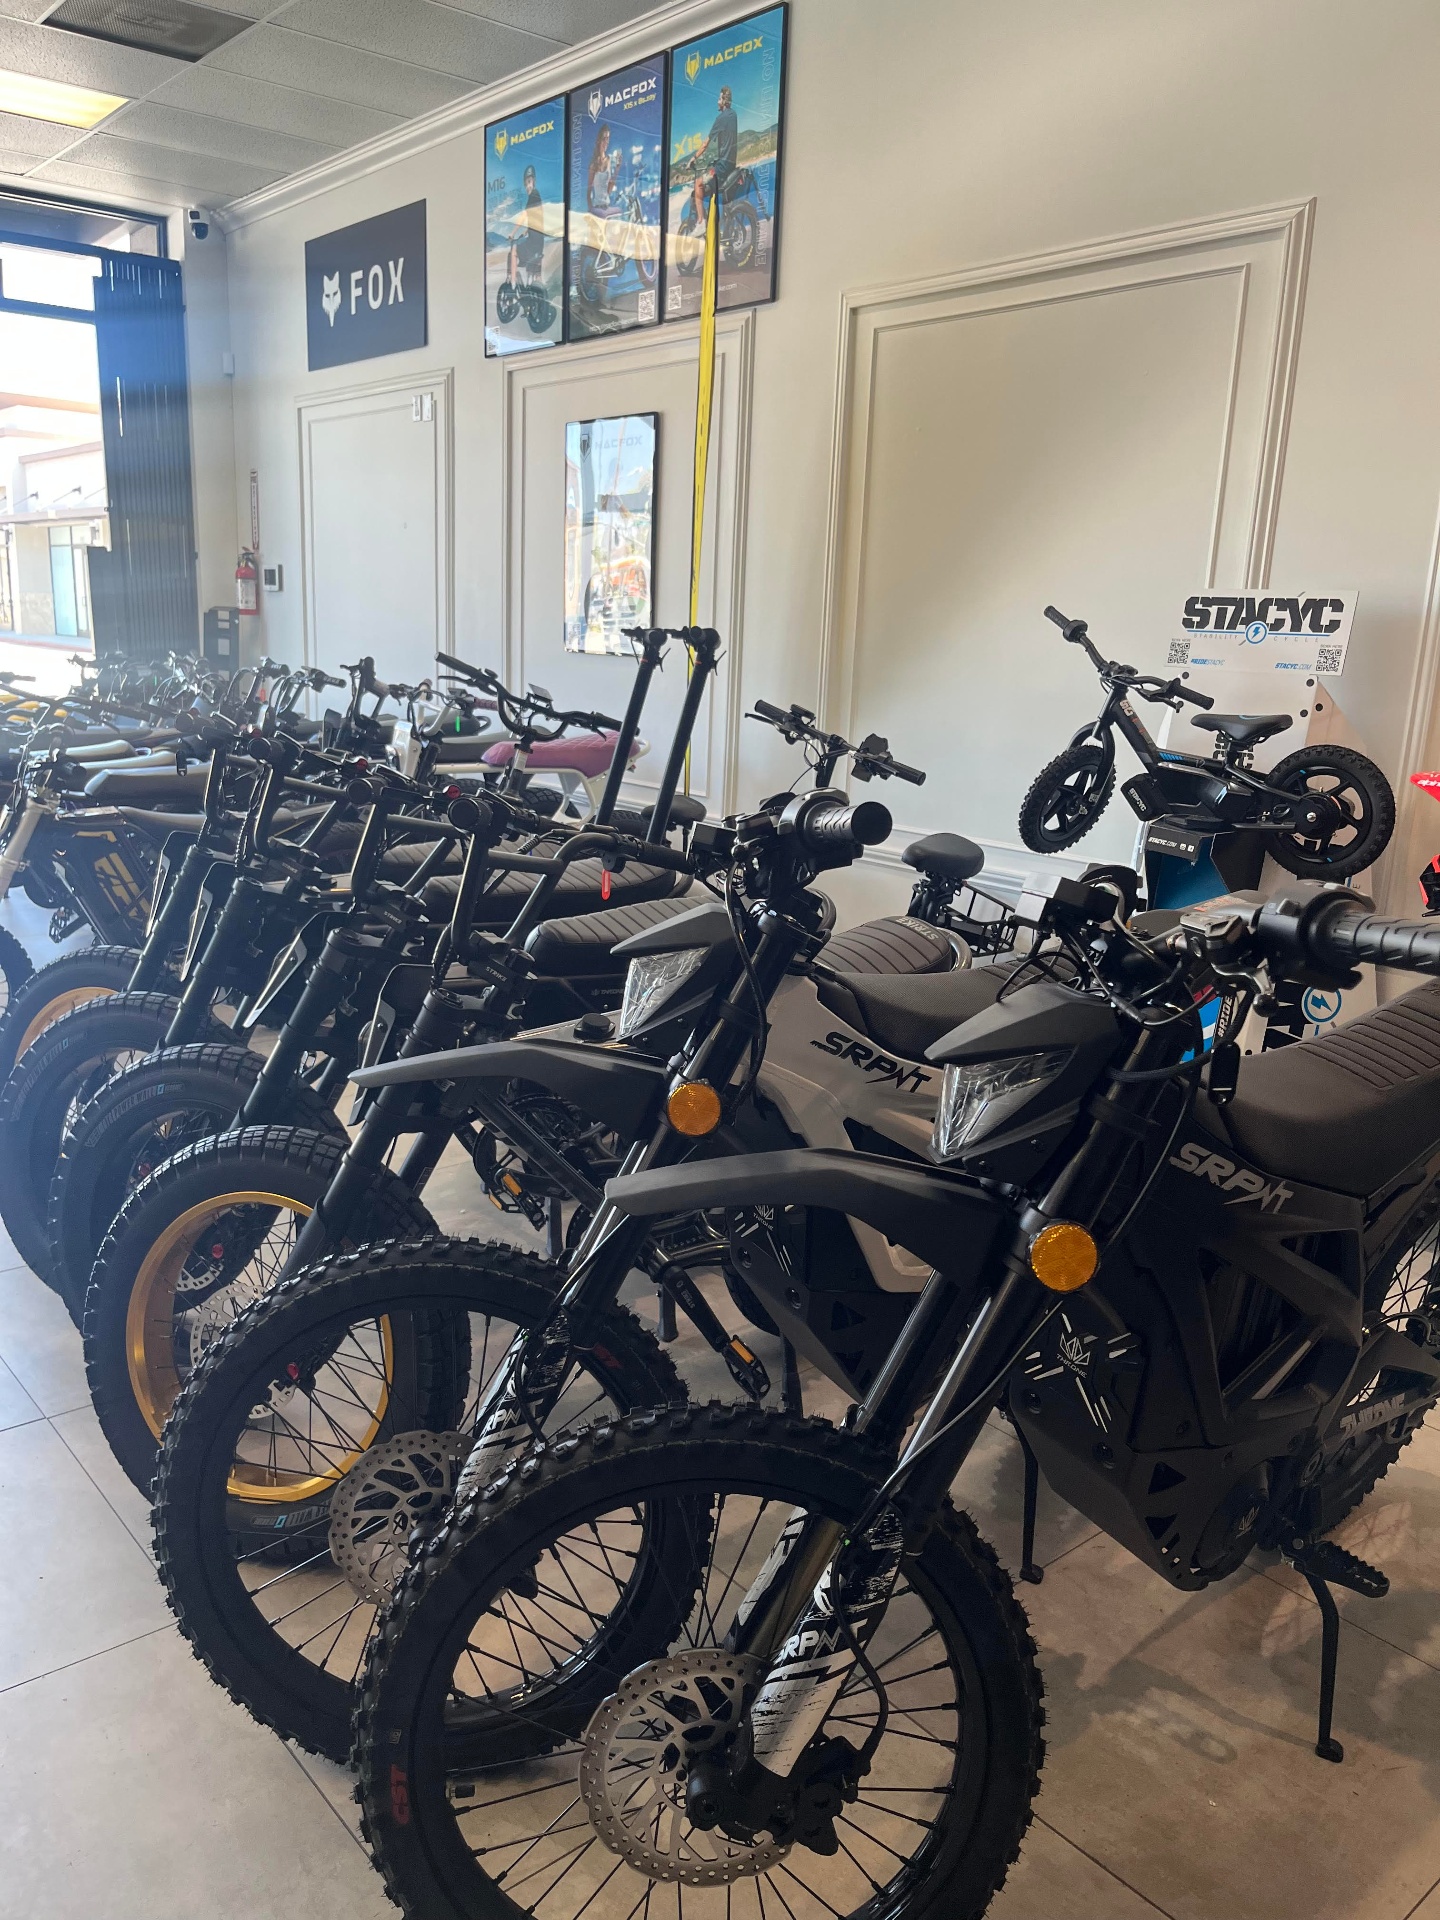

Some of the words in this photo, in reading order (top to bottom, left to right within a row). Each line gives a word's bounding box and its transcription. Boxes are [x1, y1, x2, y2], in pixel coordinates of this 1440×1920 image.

[704, 36, 763, 69] MACFOX
[605, 77, 657, 107] MACFOX
[510, 120, 555, 146] MACFOX
[351, 257, 404, 315] FOX
[1182, 597, 1344, 633] STACYC
[895, 917, 939, 940] STRIKE
[1056, 1353, 1088, 1378] THRONE
